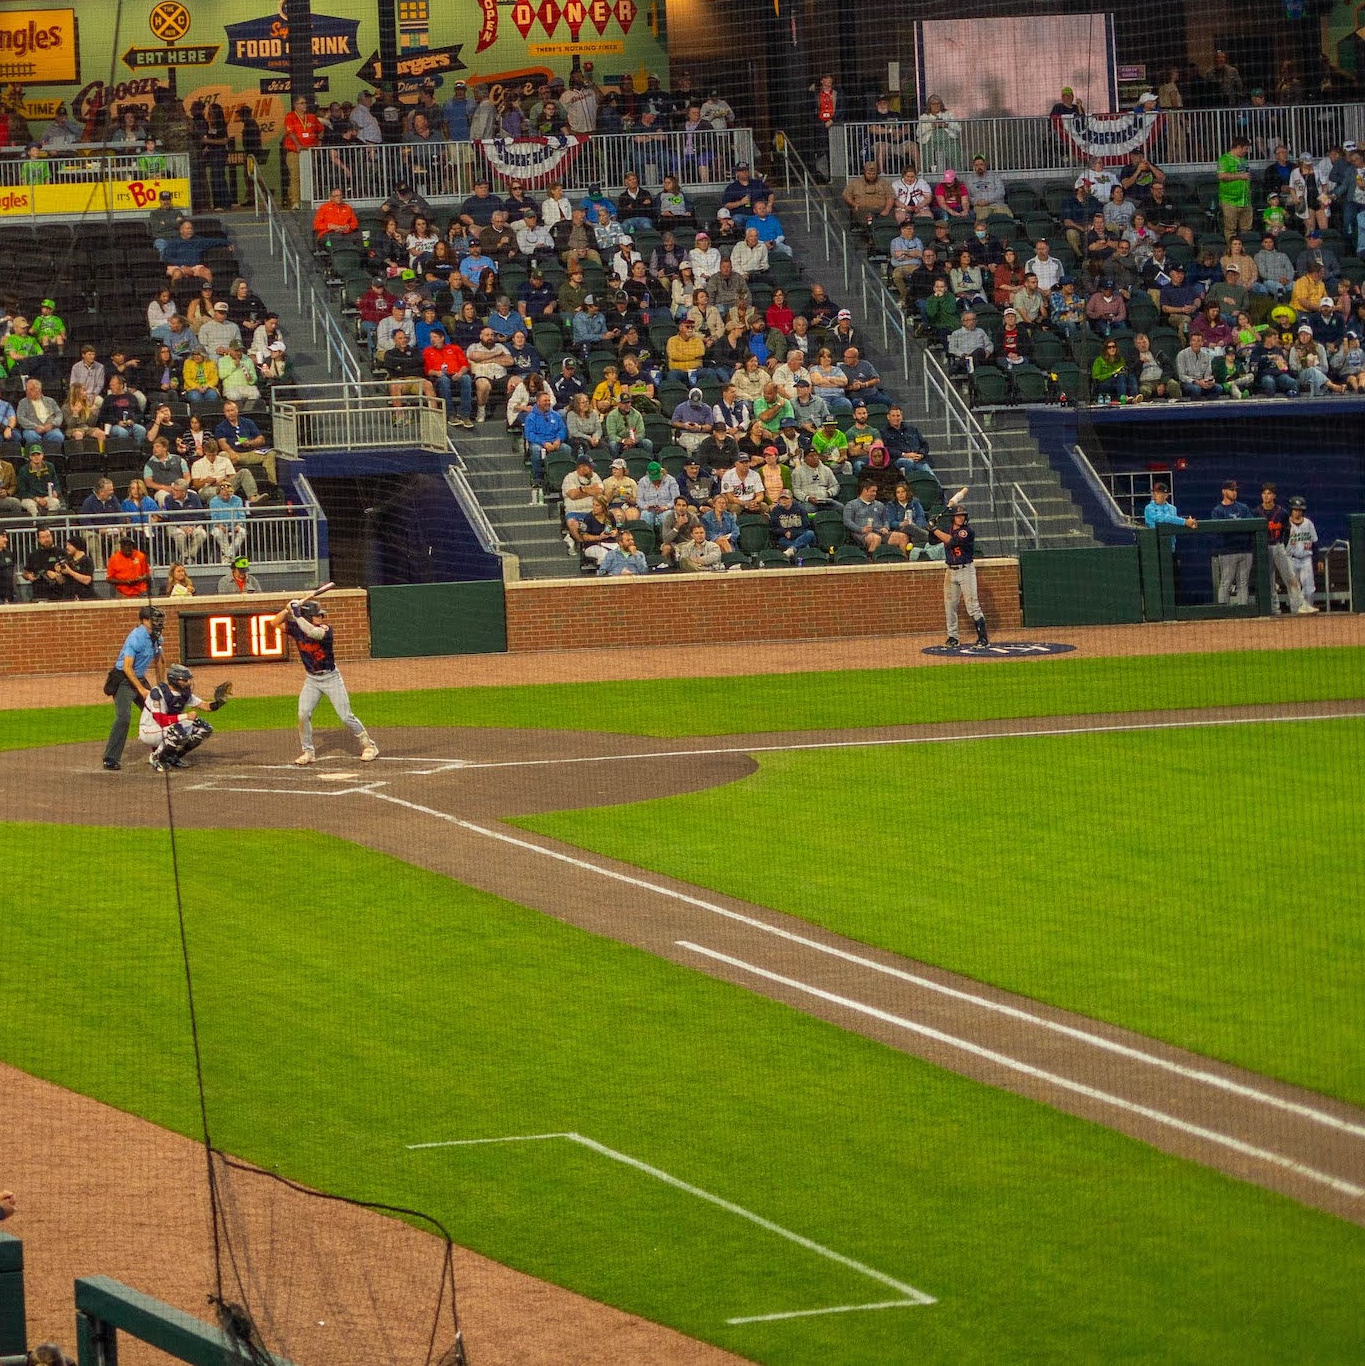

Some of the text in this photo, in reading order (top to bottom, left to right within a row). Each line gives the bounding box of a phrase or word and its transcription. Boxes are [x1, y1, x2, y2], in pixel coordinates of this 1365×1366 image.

[518, 1, 631, 25] DINER
[137, 49, 206, 65] EAT HERE
[236, 36, 351, 58] FOOD RINK
[28, 104, 54, 115] TIME
[117, 193, 130, 201] IT'S
[127, 182, 156, 208] Bo
[210, 615, 283, 657] 0:10
